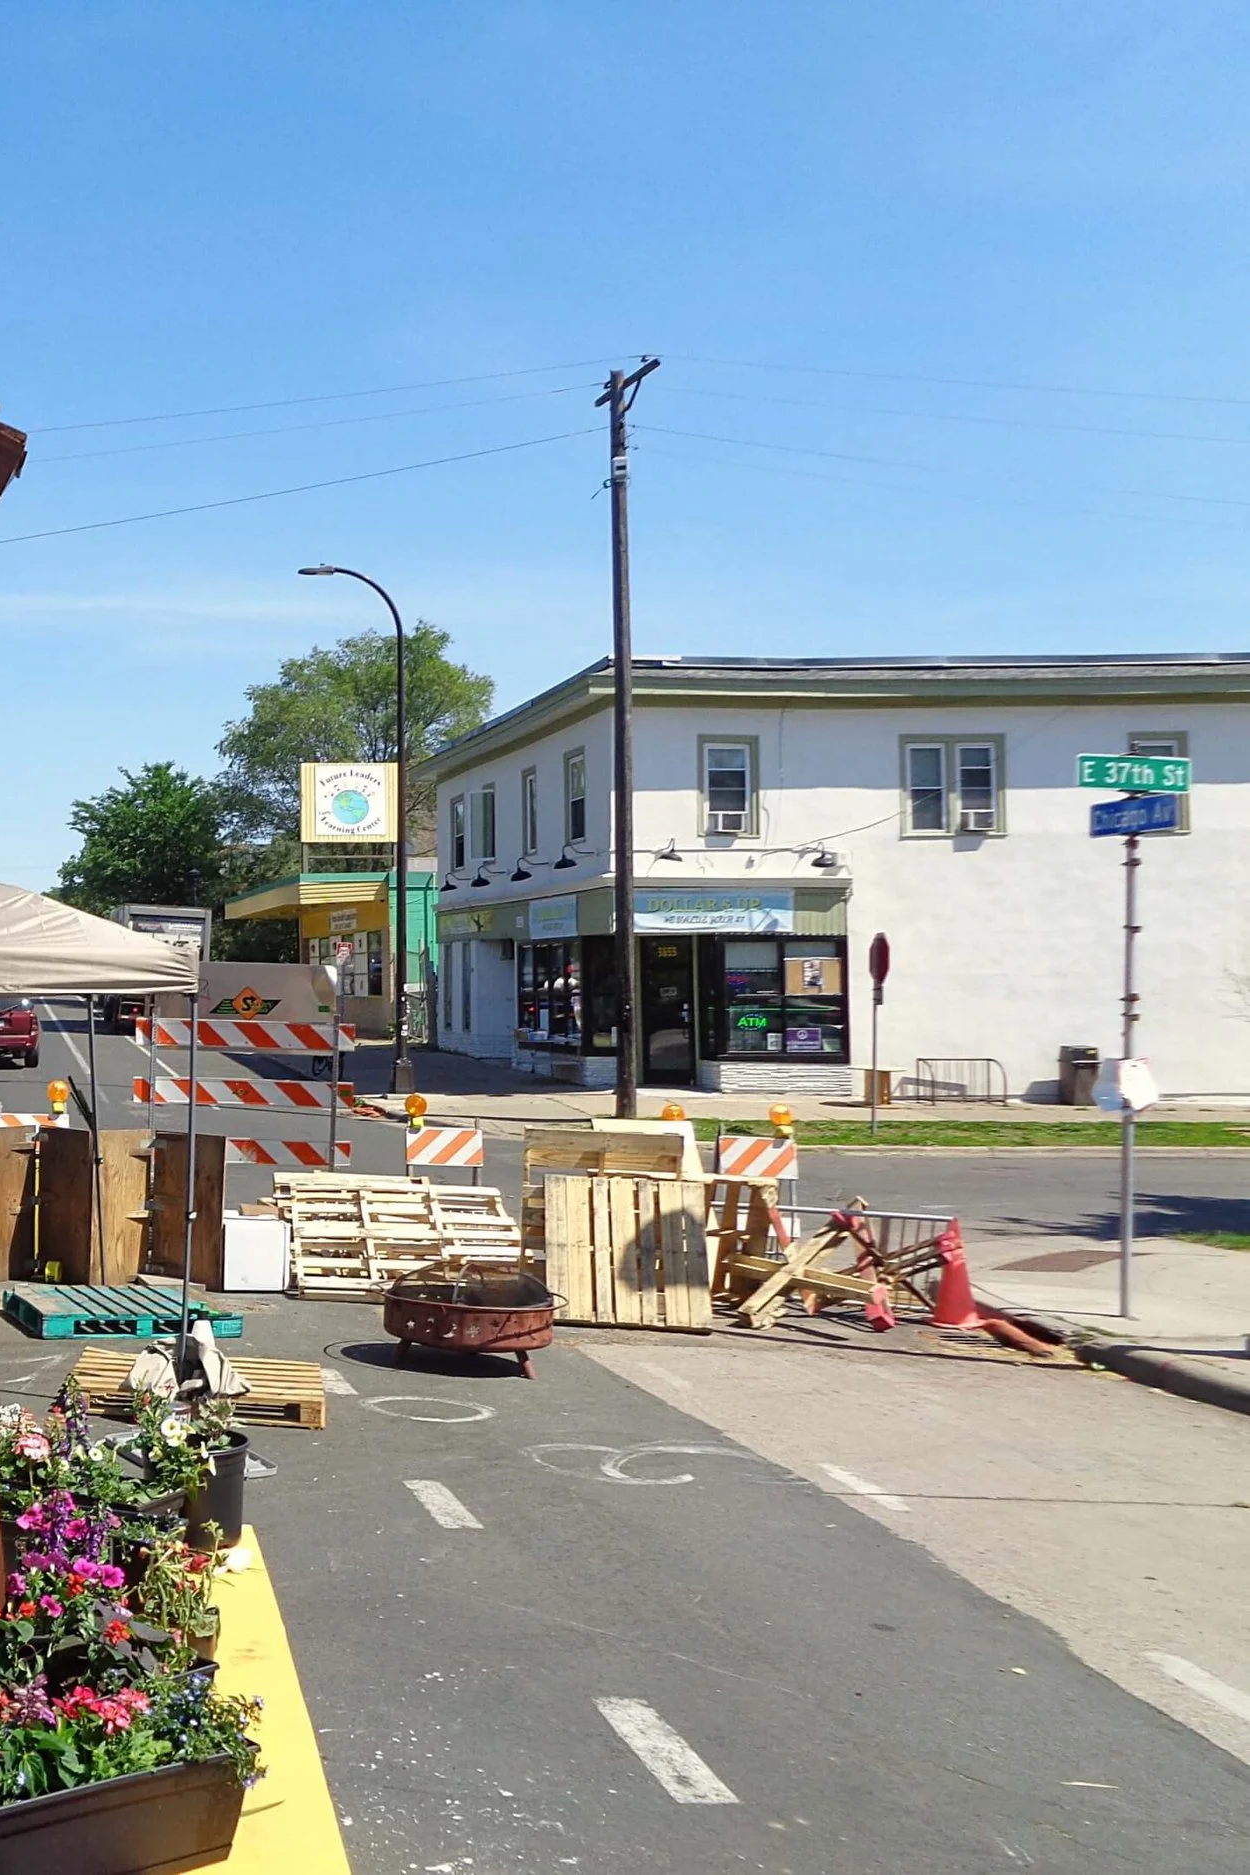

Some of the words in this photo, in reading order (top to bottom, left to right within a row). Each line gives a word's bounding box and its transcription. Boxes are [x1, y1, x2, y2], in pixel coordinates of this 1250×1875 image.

[319, 771, 347, 787] Future
[350, 769, 382, 787] Leaders
[1083, 761, 1096, 783] E
[1105, 761, 1155, 785] 37th
[1163, 764, 1186, 787] St
[320, 815, 355, 835] Learning
[357, 816, 382, 833] Center
[647, 898, 718, 913] DOLLAR
[737, 898, 762, 912] UP
[737, 1016, 768, 1028] ATM
